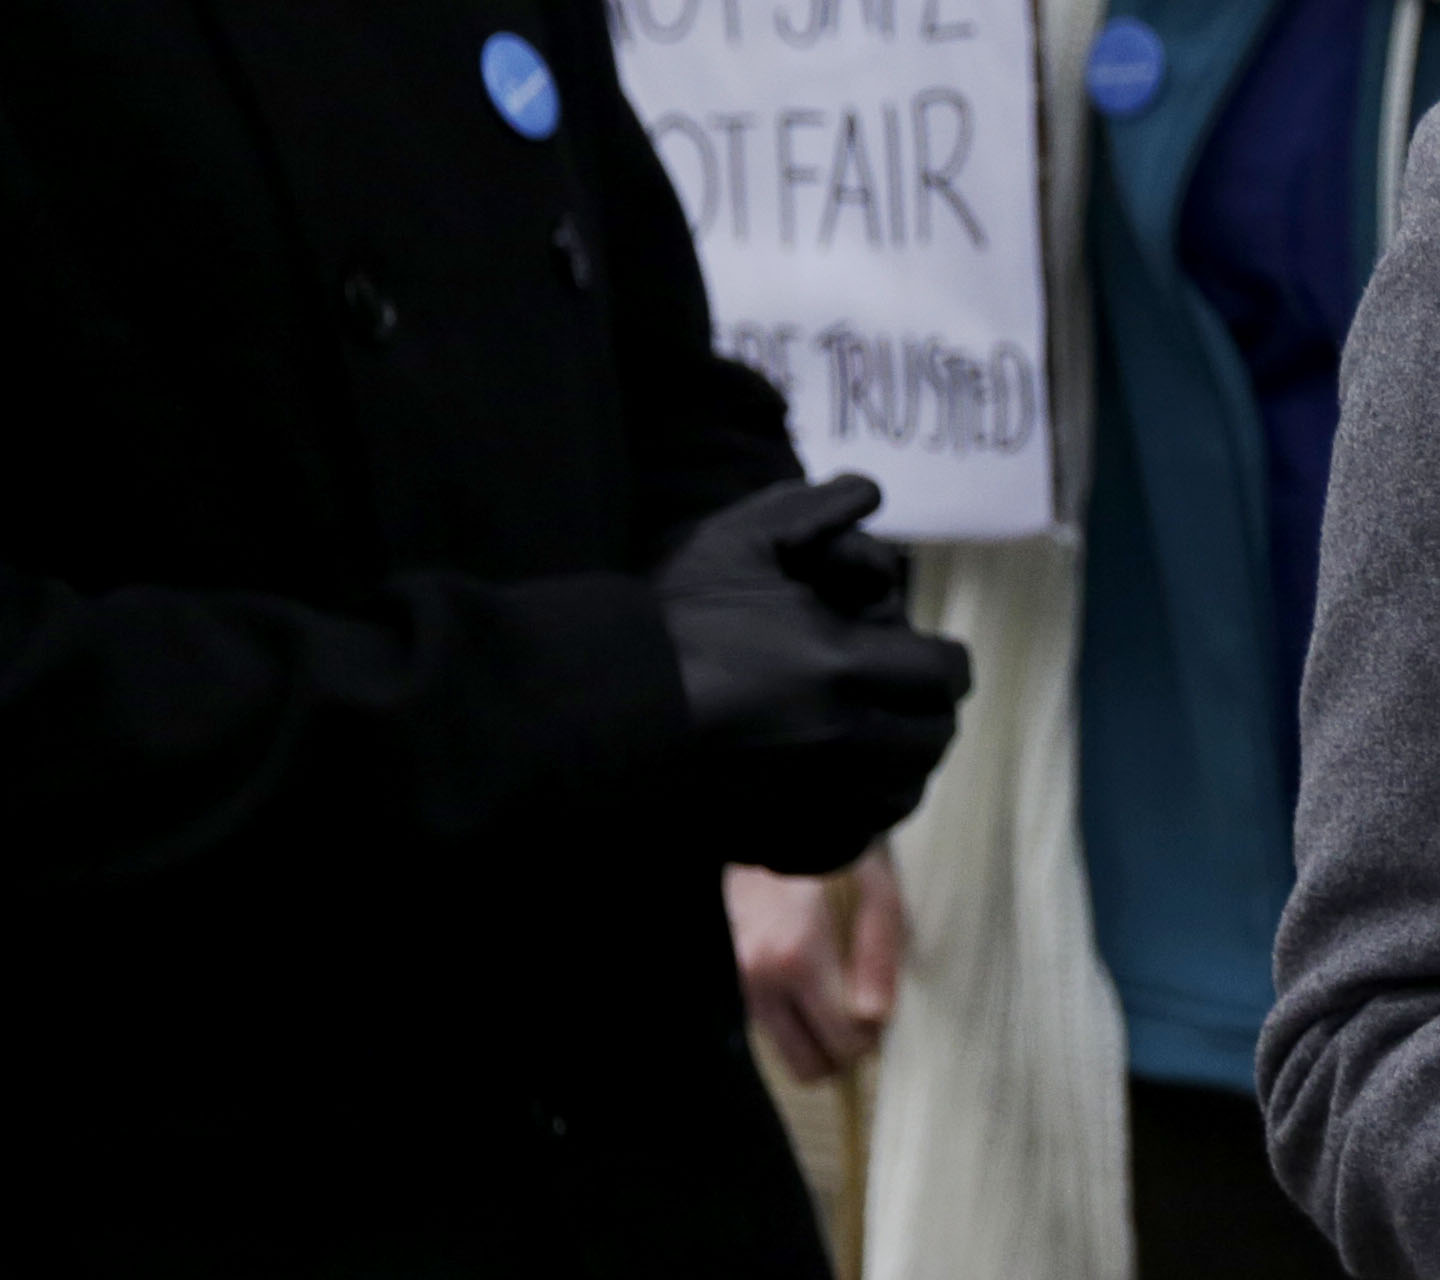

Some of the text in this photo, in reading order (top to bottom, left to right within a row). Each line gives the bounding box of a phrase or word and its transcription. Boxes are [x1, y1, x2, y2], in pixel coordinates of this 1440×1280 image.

[652, 87, 989, 253] OT FAIR
[817, 321, 1036, 456] TRUSTED
